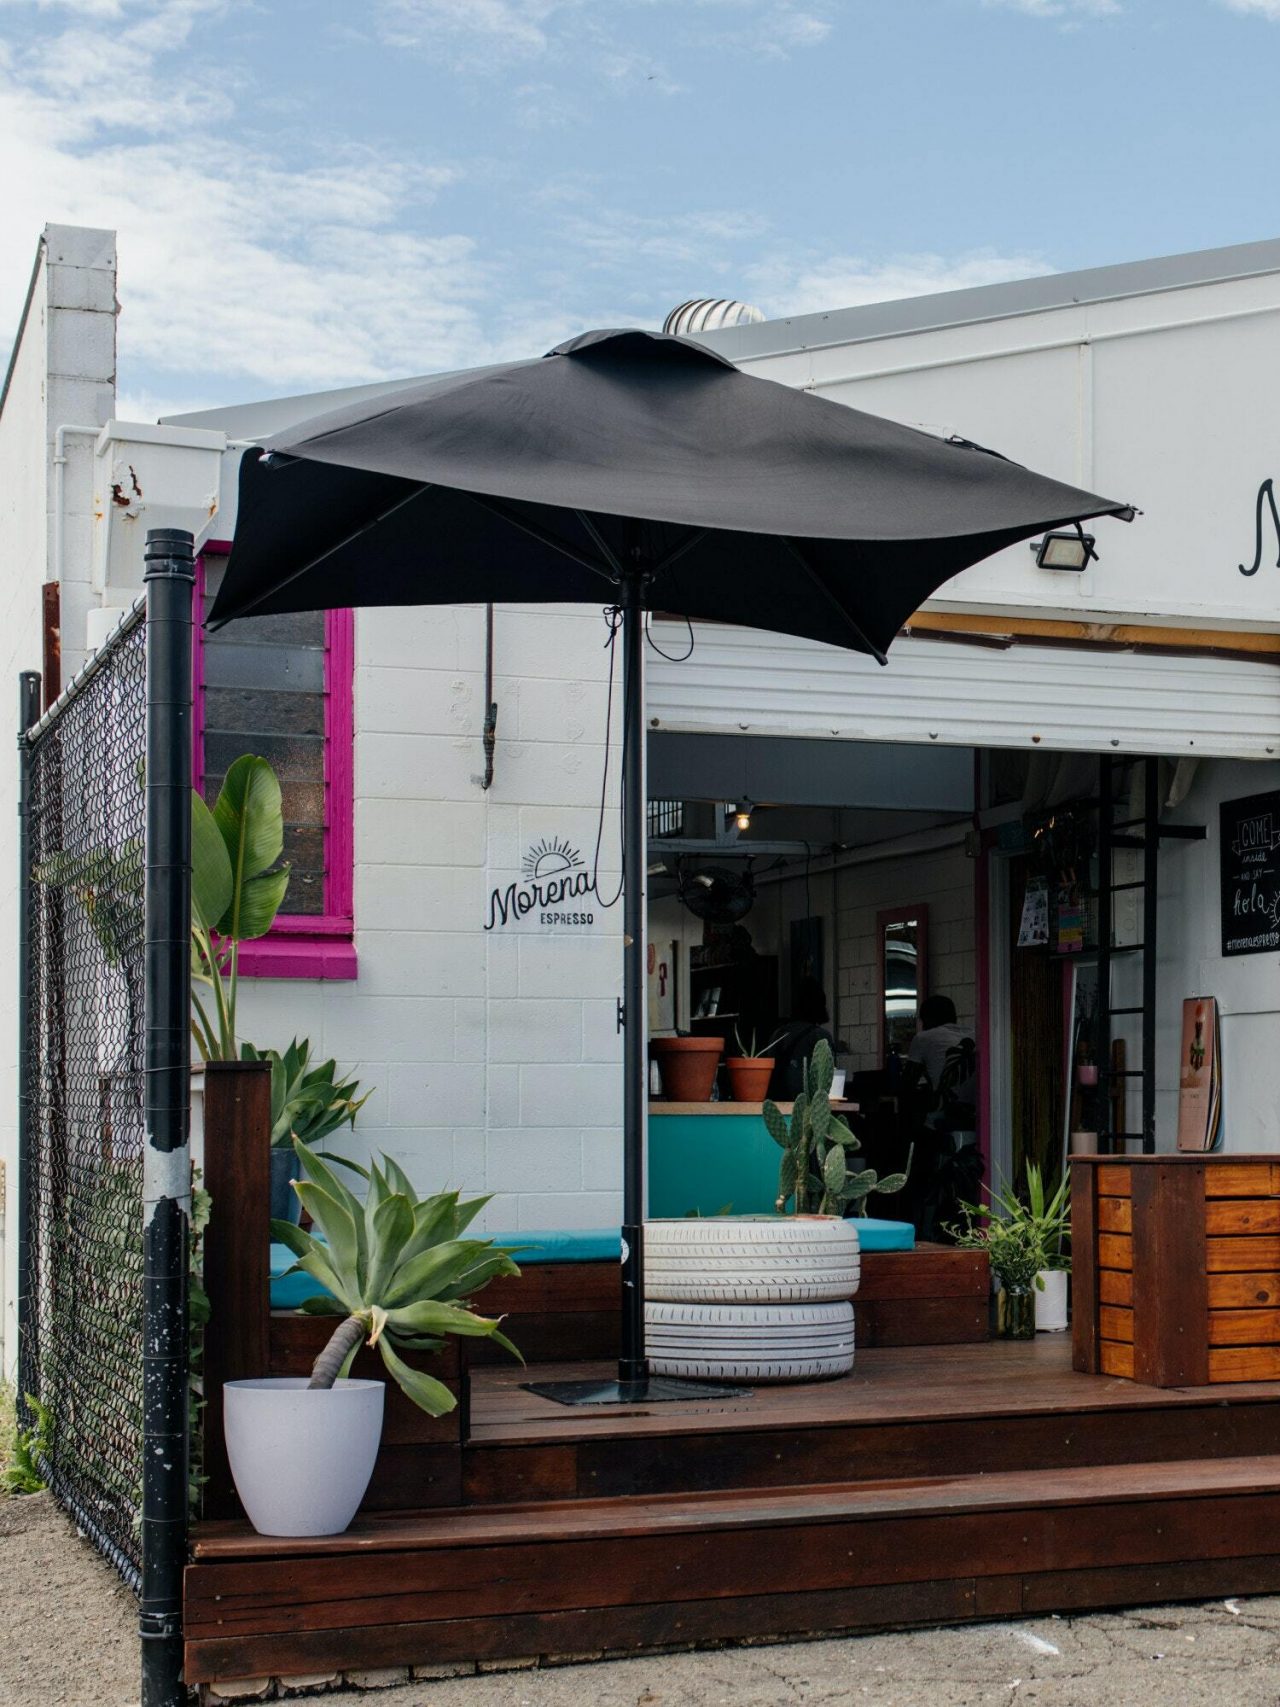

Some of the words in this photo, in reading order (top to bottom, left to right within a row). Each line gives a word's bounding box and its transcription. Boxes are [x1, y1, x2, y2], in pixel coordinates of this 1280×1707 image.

[1242, 818, 1270, 847] COME
[1241, 851, 1268, 864] inside
[483, 871, 596, 931] Morena
[1233, 883, 1270, 916] hola
[540, 912, 594, 926] ESPRESSO
